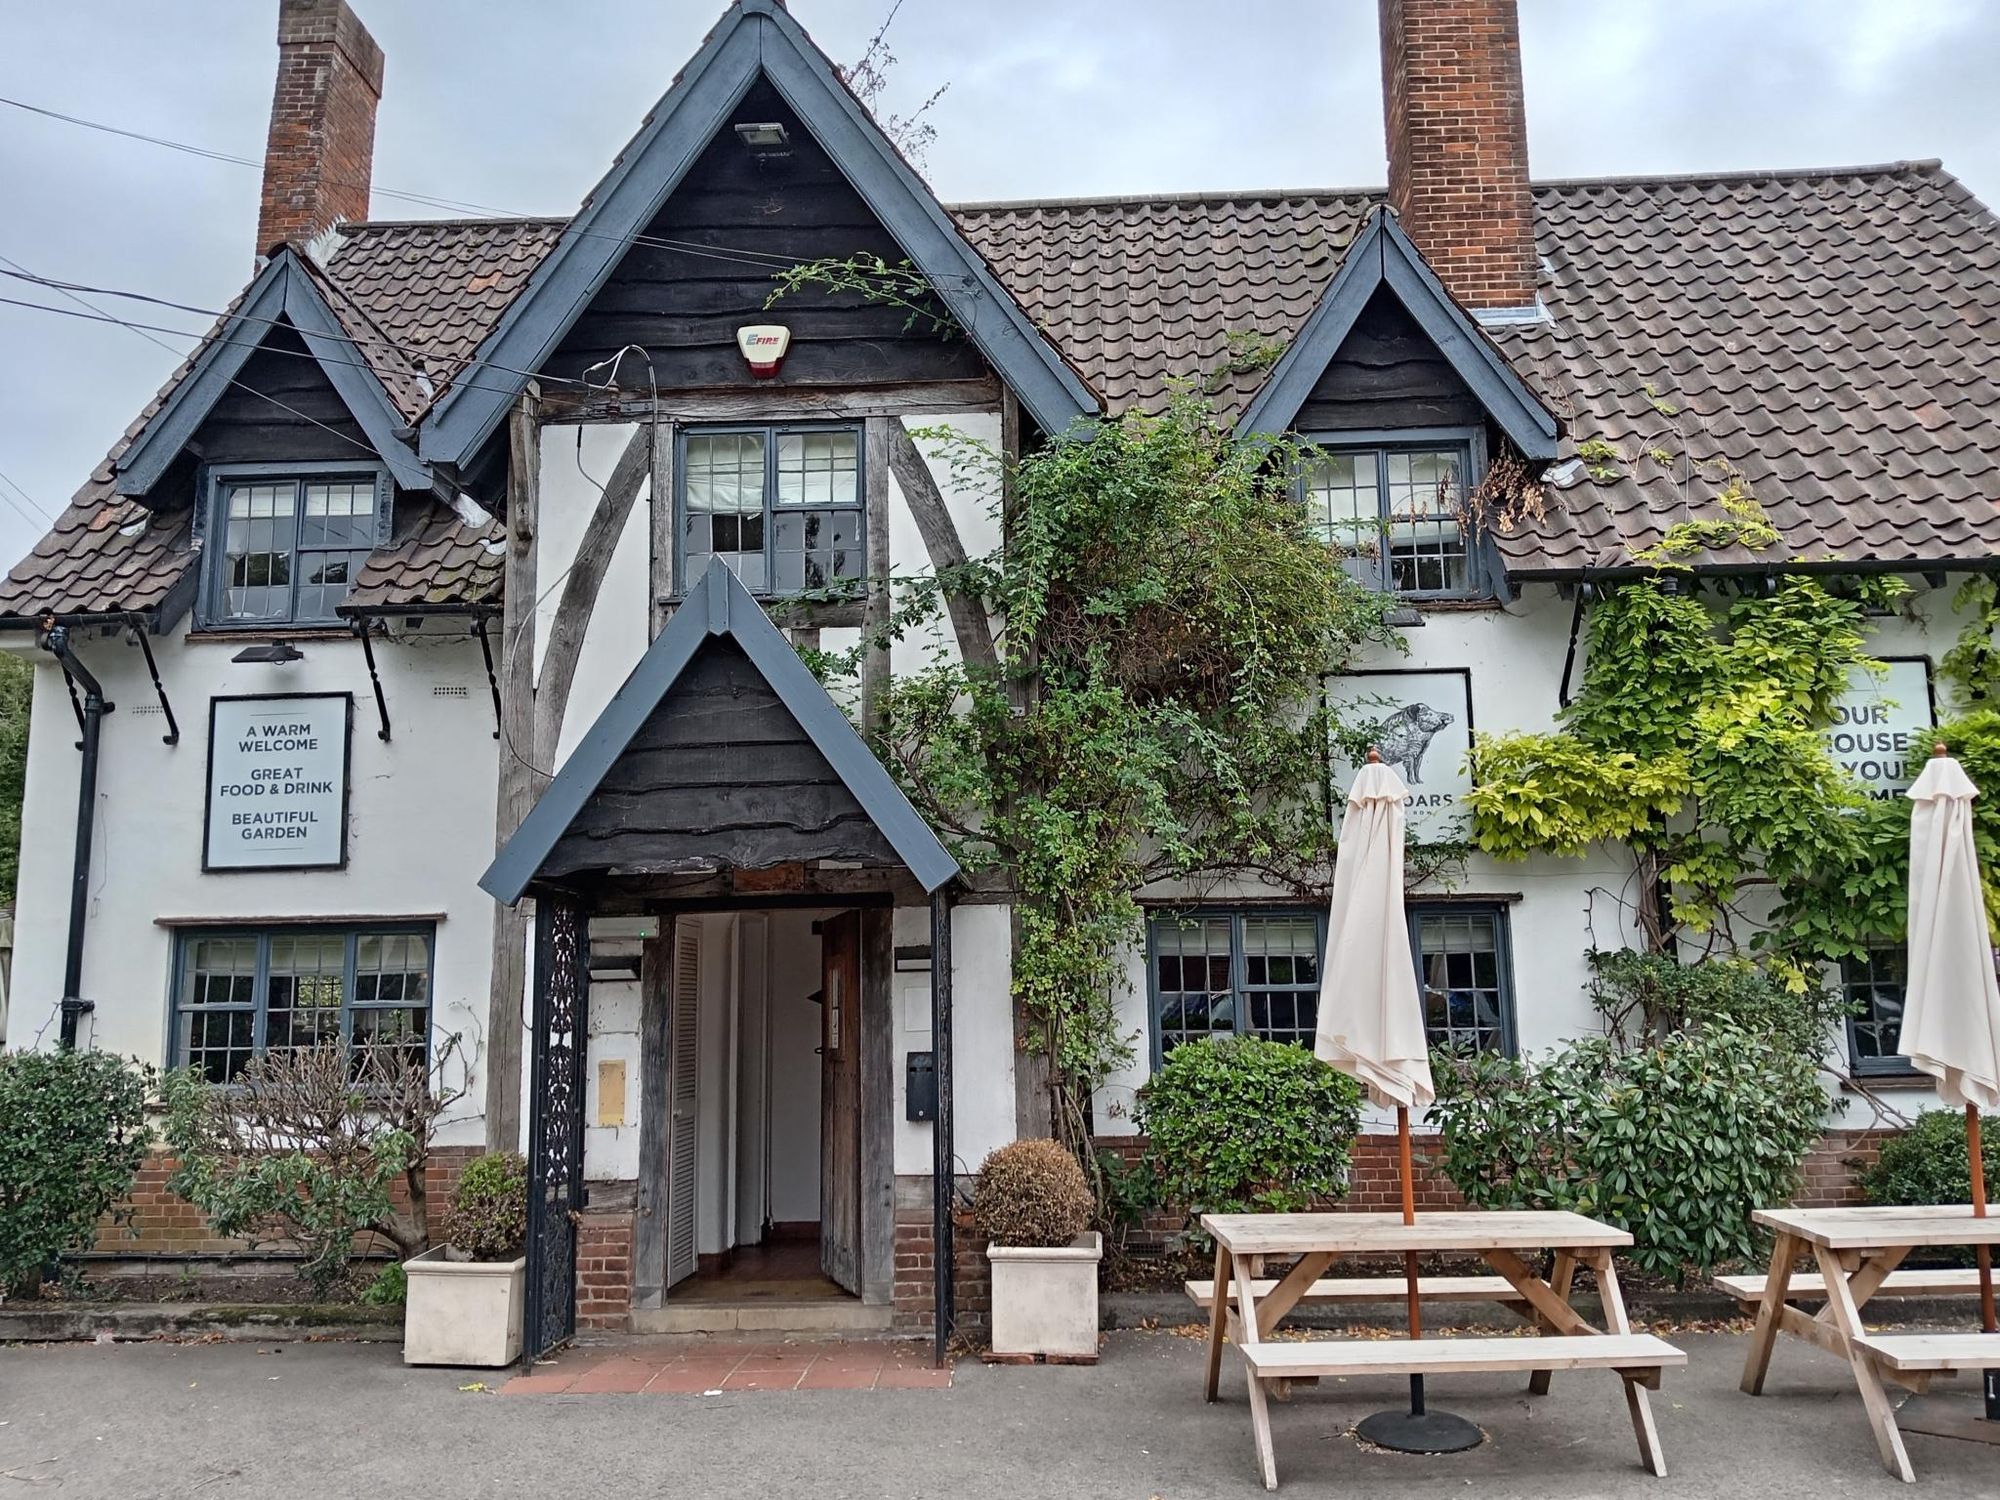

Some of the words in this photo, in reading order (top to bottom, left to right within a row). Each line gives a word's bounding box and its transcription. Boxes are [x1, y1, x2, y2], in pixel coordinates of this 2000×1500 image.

[1828, 705, 1888, 725] OUR
[246, 726, 257, 737] A
[262, 724, 311, 737] WARM
[238, 739, 318, 752] WELCOME
[251, 767, 303, 780] GREAT
[220, 784, 265, 796] FOOD
[269, 784, 279, 795] &
[284, 782, 333, 794] DRINK
[1403, 794, 1453, 807] OARS
[232, 811, 318, 825] BEAUTIFUL
[241, 827, 307, 840] GARDEN
